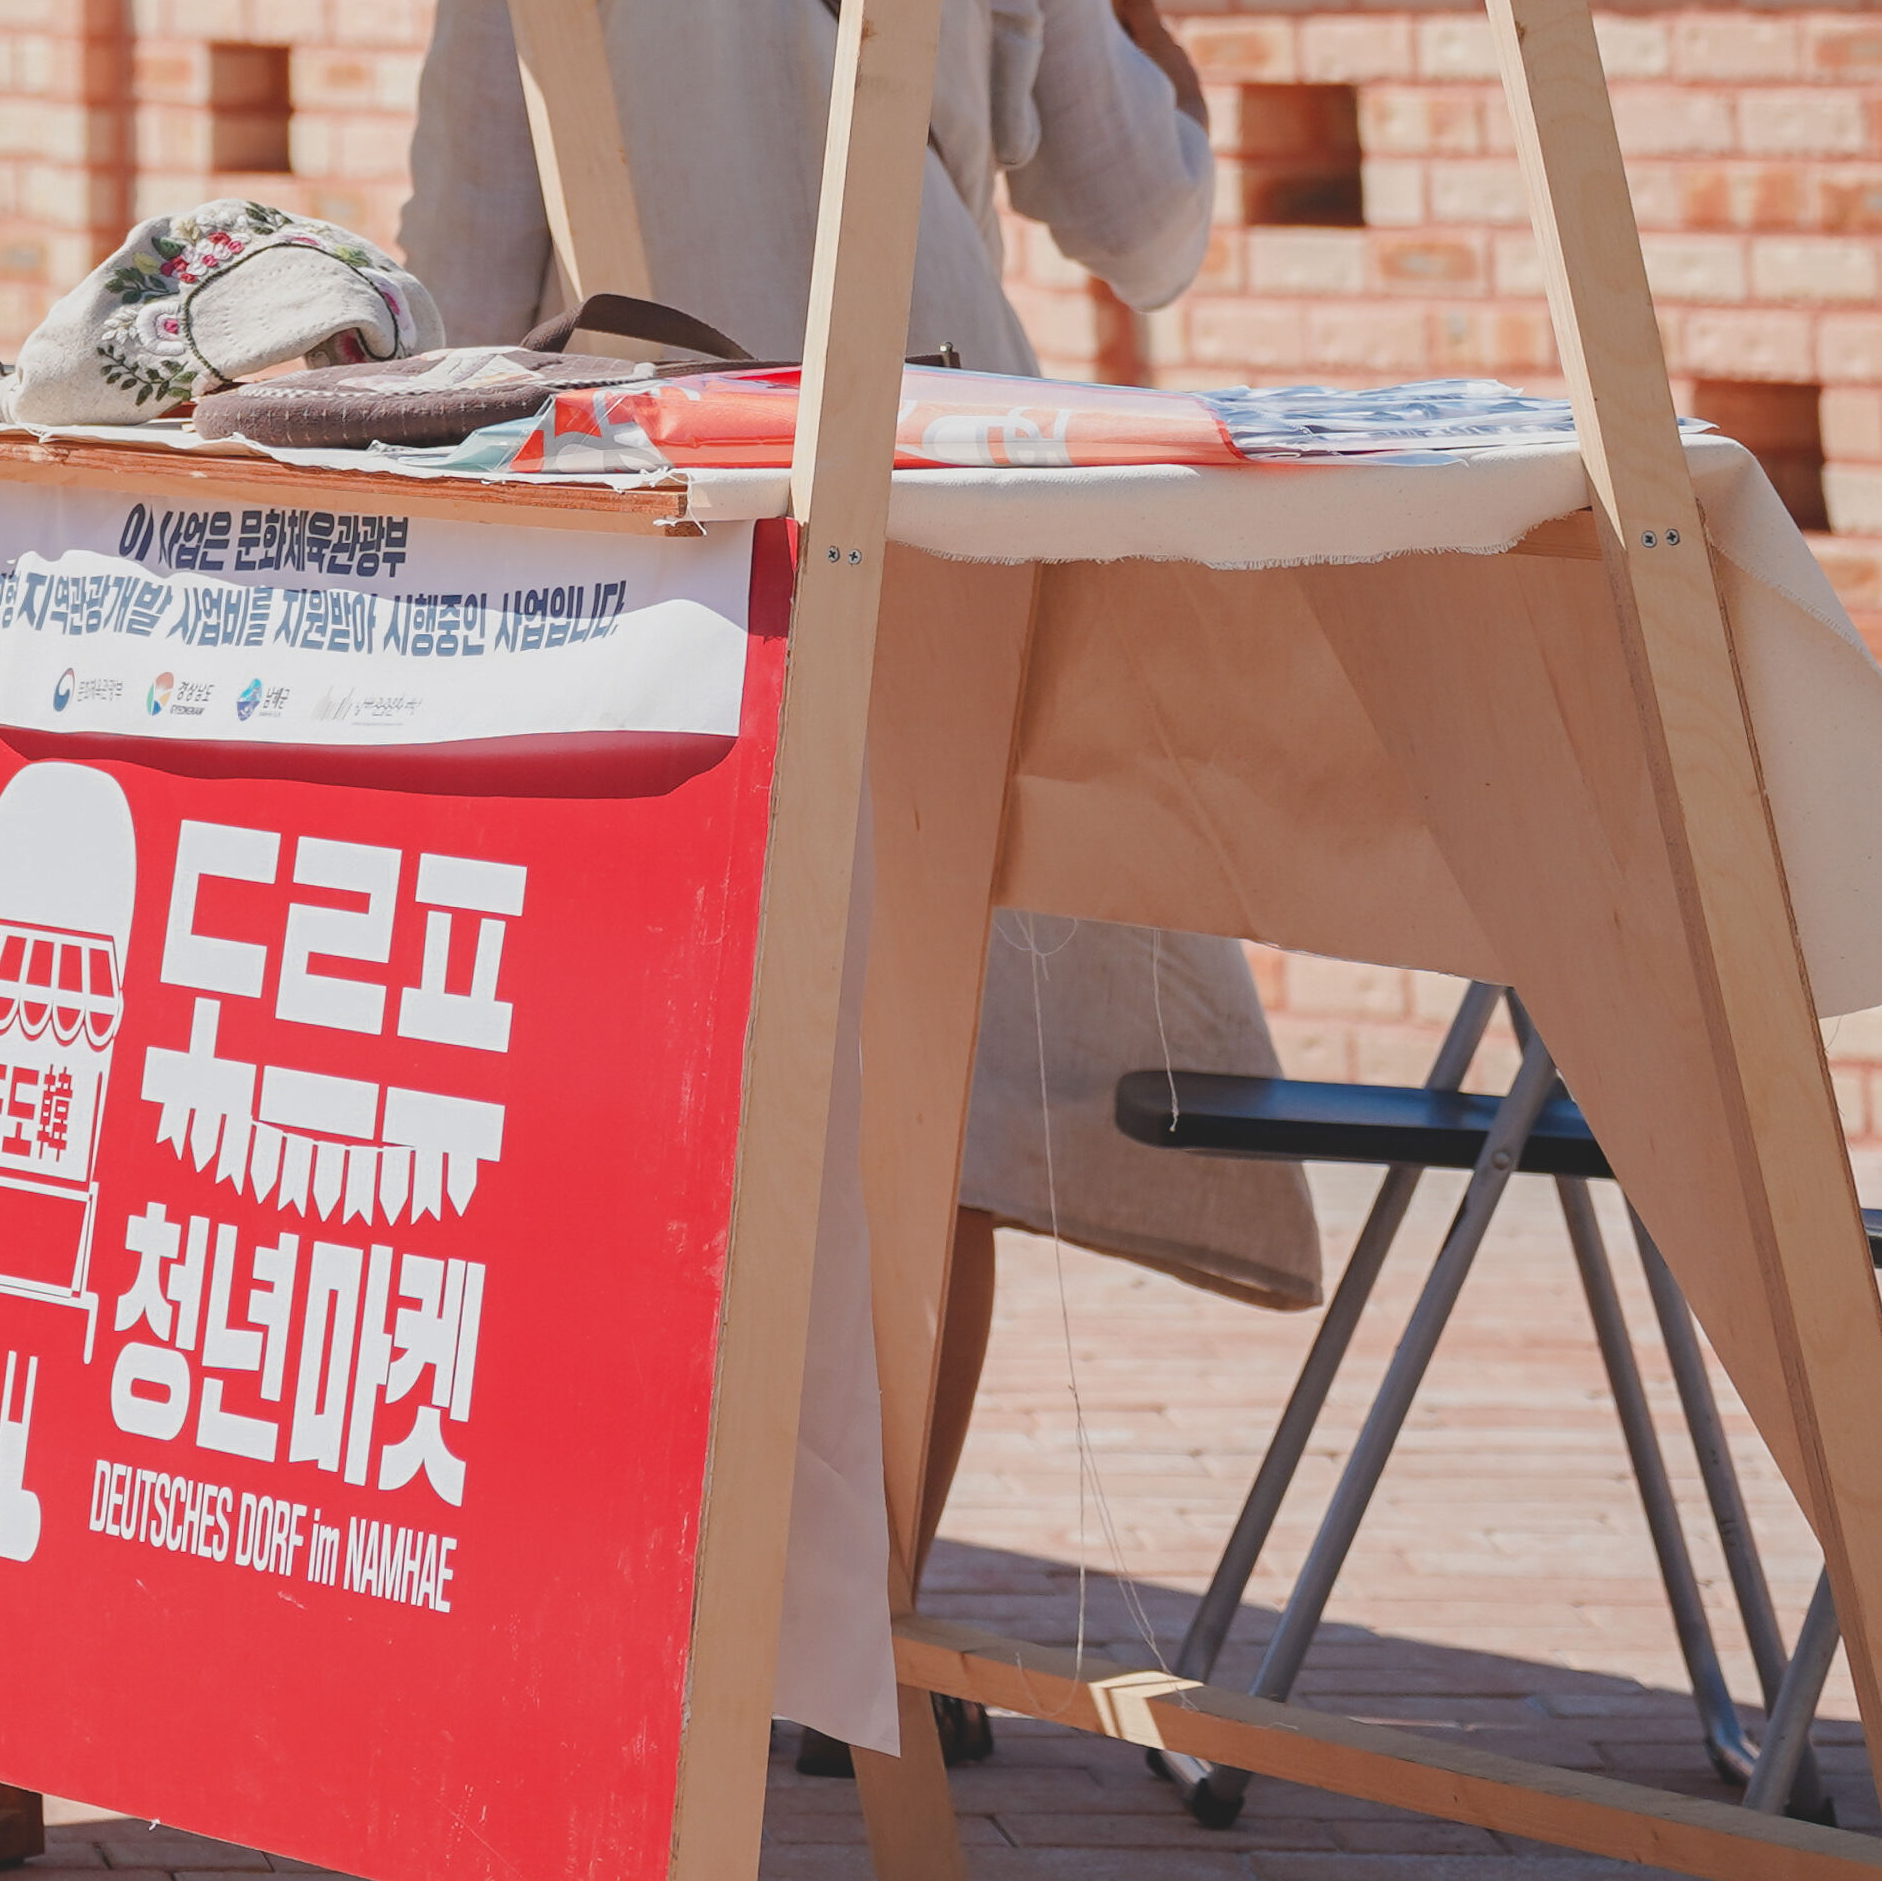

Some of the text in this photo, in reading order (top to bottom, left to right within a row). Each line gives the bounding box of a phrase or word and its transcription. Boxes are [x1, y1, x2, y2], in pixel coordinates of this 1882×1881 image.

[118, 503, 409, 578] 이 사업은 문화체육관광부
[18, 571, 172, 637] 지역관광개발
[167, 586, 274, 647] 사업비를
[274, 588, 378, 654] 지원받아
[383, 592, 487, 657] 시행중인
[177, 681, 214, 702] 경상남도
[111, 1200, 486, 1507] 청년마켓
[90, 1459, 458, 1613] DEUTSCHES DORF im NAMHAE
